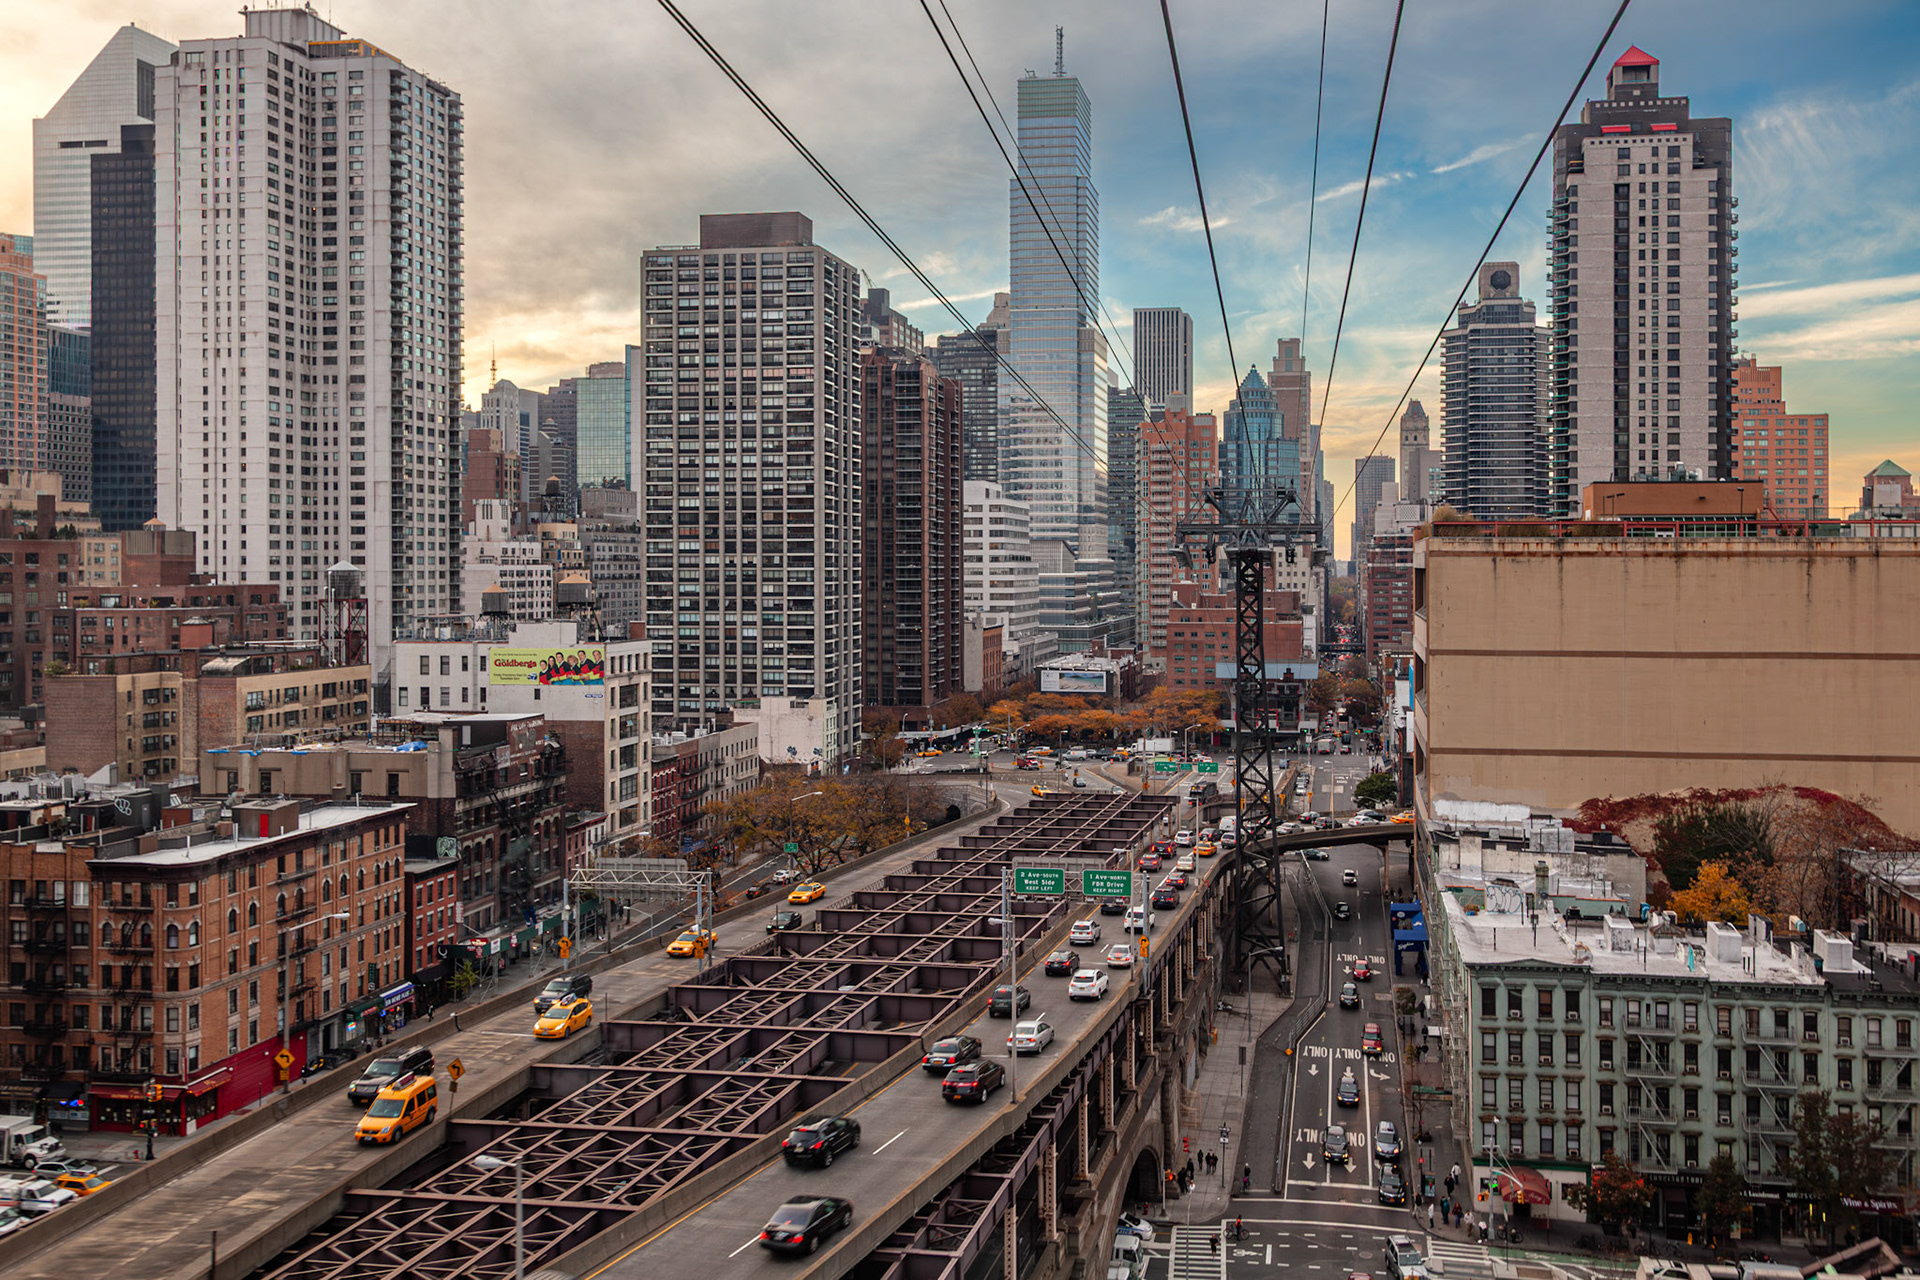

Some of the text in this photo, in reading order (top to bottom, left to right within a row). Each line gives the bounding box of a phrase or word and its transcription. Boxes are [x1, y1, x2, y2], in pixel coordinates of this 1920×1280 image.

[494, 659, 537, 669] Goldbergs
[1337, 954, 1358, 962] ONLY
[1303, 1046, 1328, 1057] ONLY
[1335, 1048, 1361, 1060] ONLY
[1840, 1197, 1862, 1208] Wine
[1870, 1199, 1898, 1211] Spirits
